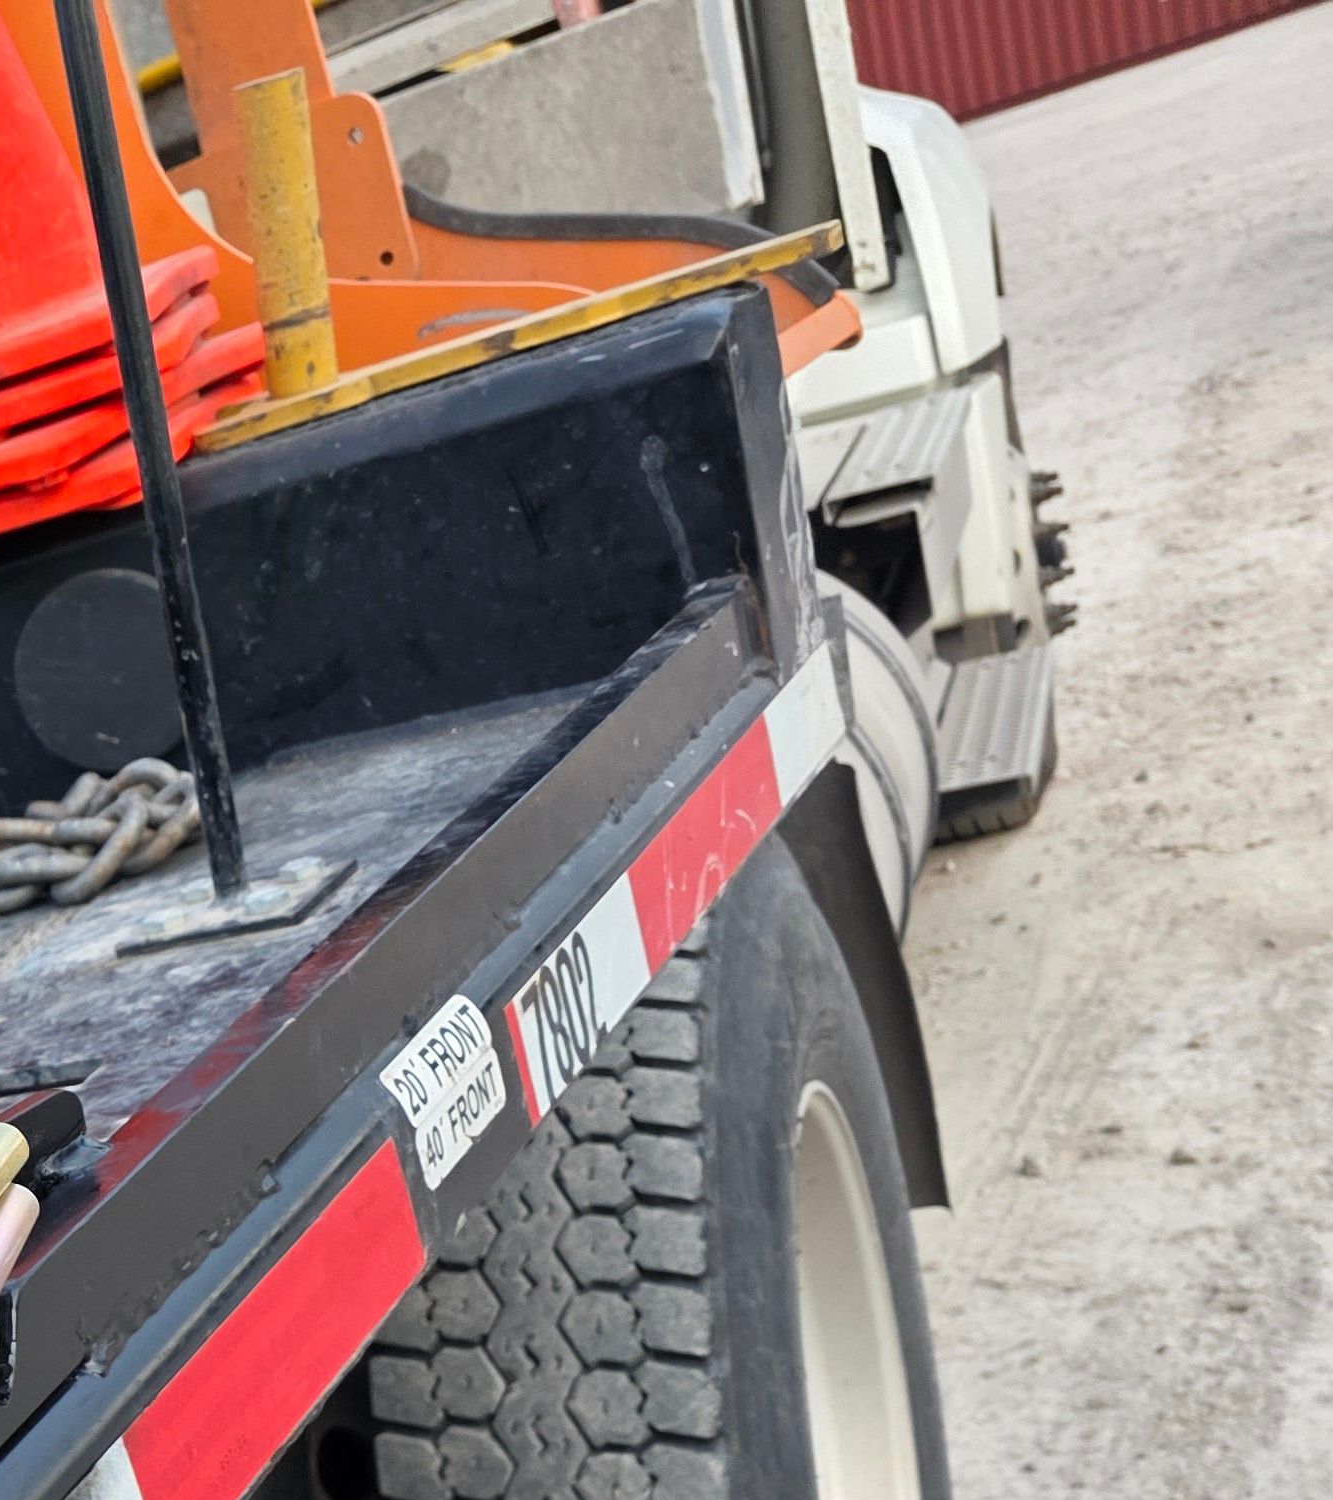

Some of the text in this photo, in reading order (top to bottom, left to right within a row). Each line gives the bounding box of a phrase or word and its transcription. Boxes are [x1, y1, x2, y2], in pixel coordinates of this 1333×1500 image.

[417, 1004, 486, 1088] FRONT
[521, 931, 606, 1106] 7802
[448, 1061, 498, 1144] FRONT
